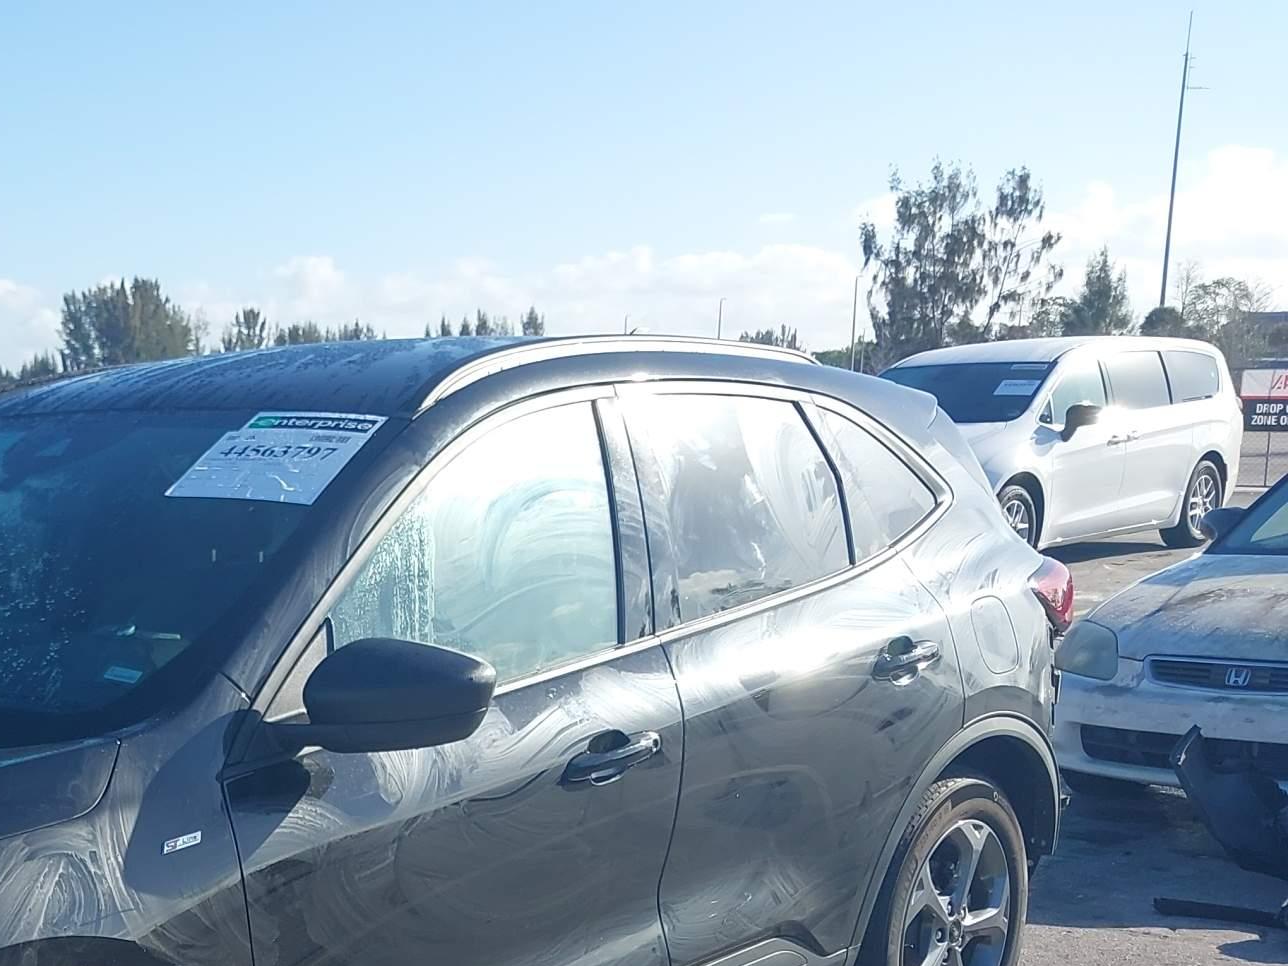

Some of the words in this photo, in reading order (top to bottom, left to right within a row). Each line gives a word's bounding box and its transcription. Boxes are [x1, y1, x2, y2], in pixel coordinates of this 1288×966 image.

[1256, 403, 1284, 414] DROP
[256, 417, 373, 430] enterprise
[1251, 415, 1278, 426] ZONE
[220, 445, 339, 460] 44563797
